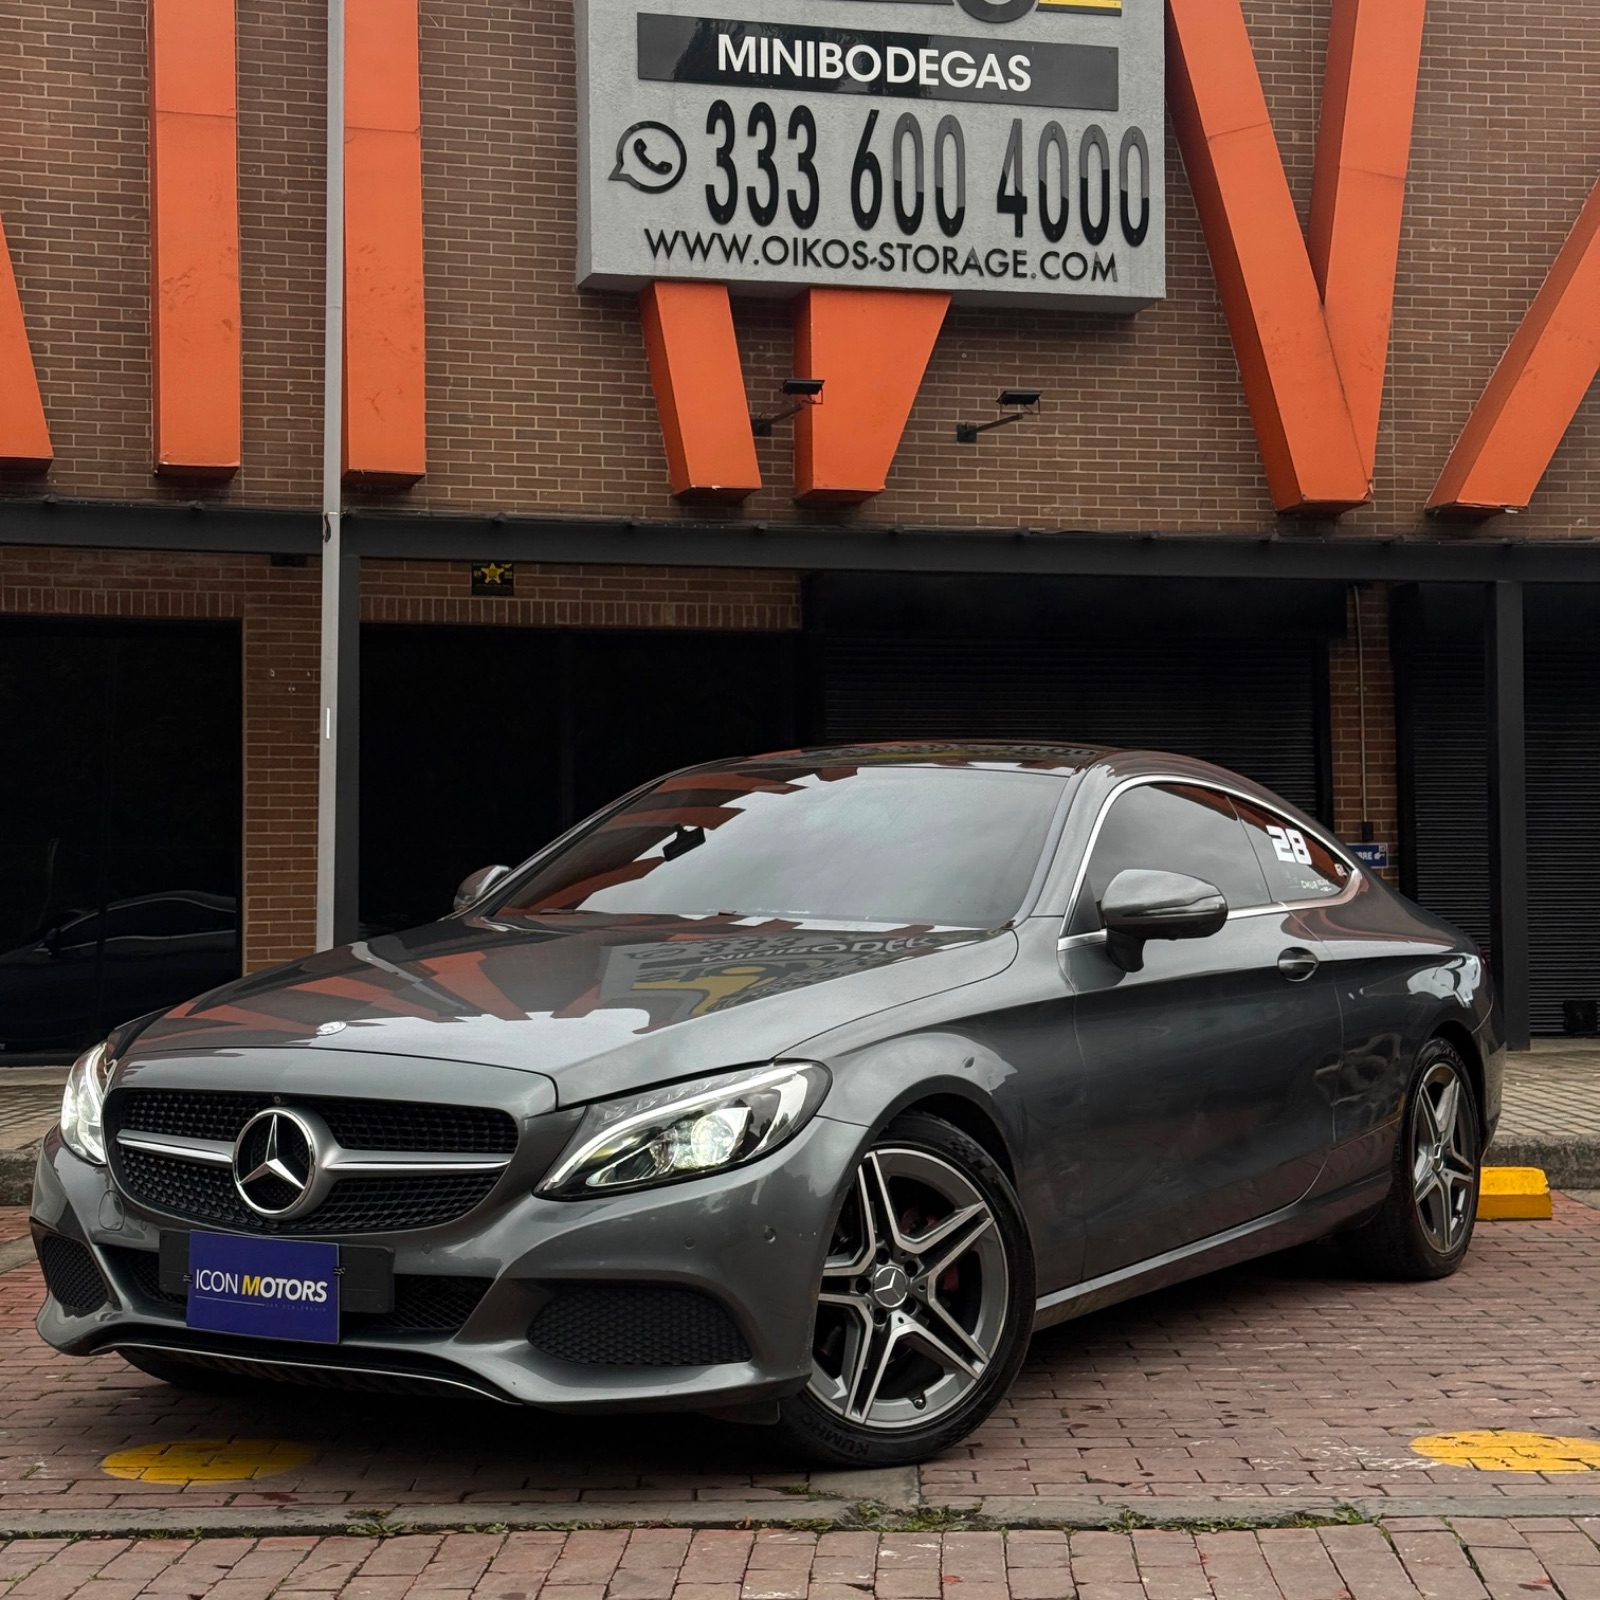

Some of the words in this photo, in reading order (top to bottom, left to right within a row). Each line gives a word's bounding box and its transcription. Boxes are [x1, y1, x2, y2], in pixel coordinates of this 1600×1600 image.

[717, 34, 1032, 92] MINIBODEGAS
[705, 99, 820, 230] 333
[850, 109, 966, 237] 600
[996, 118, 1150, 247] 4000
[644, 228, 1119, 283] WWW.OIKOS-STORAGE.COM
[1265, 824, 1312, 866] 28
[195, 1269, 238, 1294] ICON
[241, 1275, 328, 1303] MOTORS
